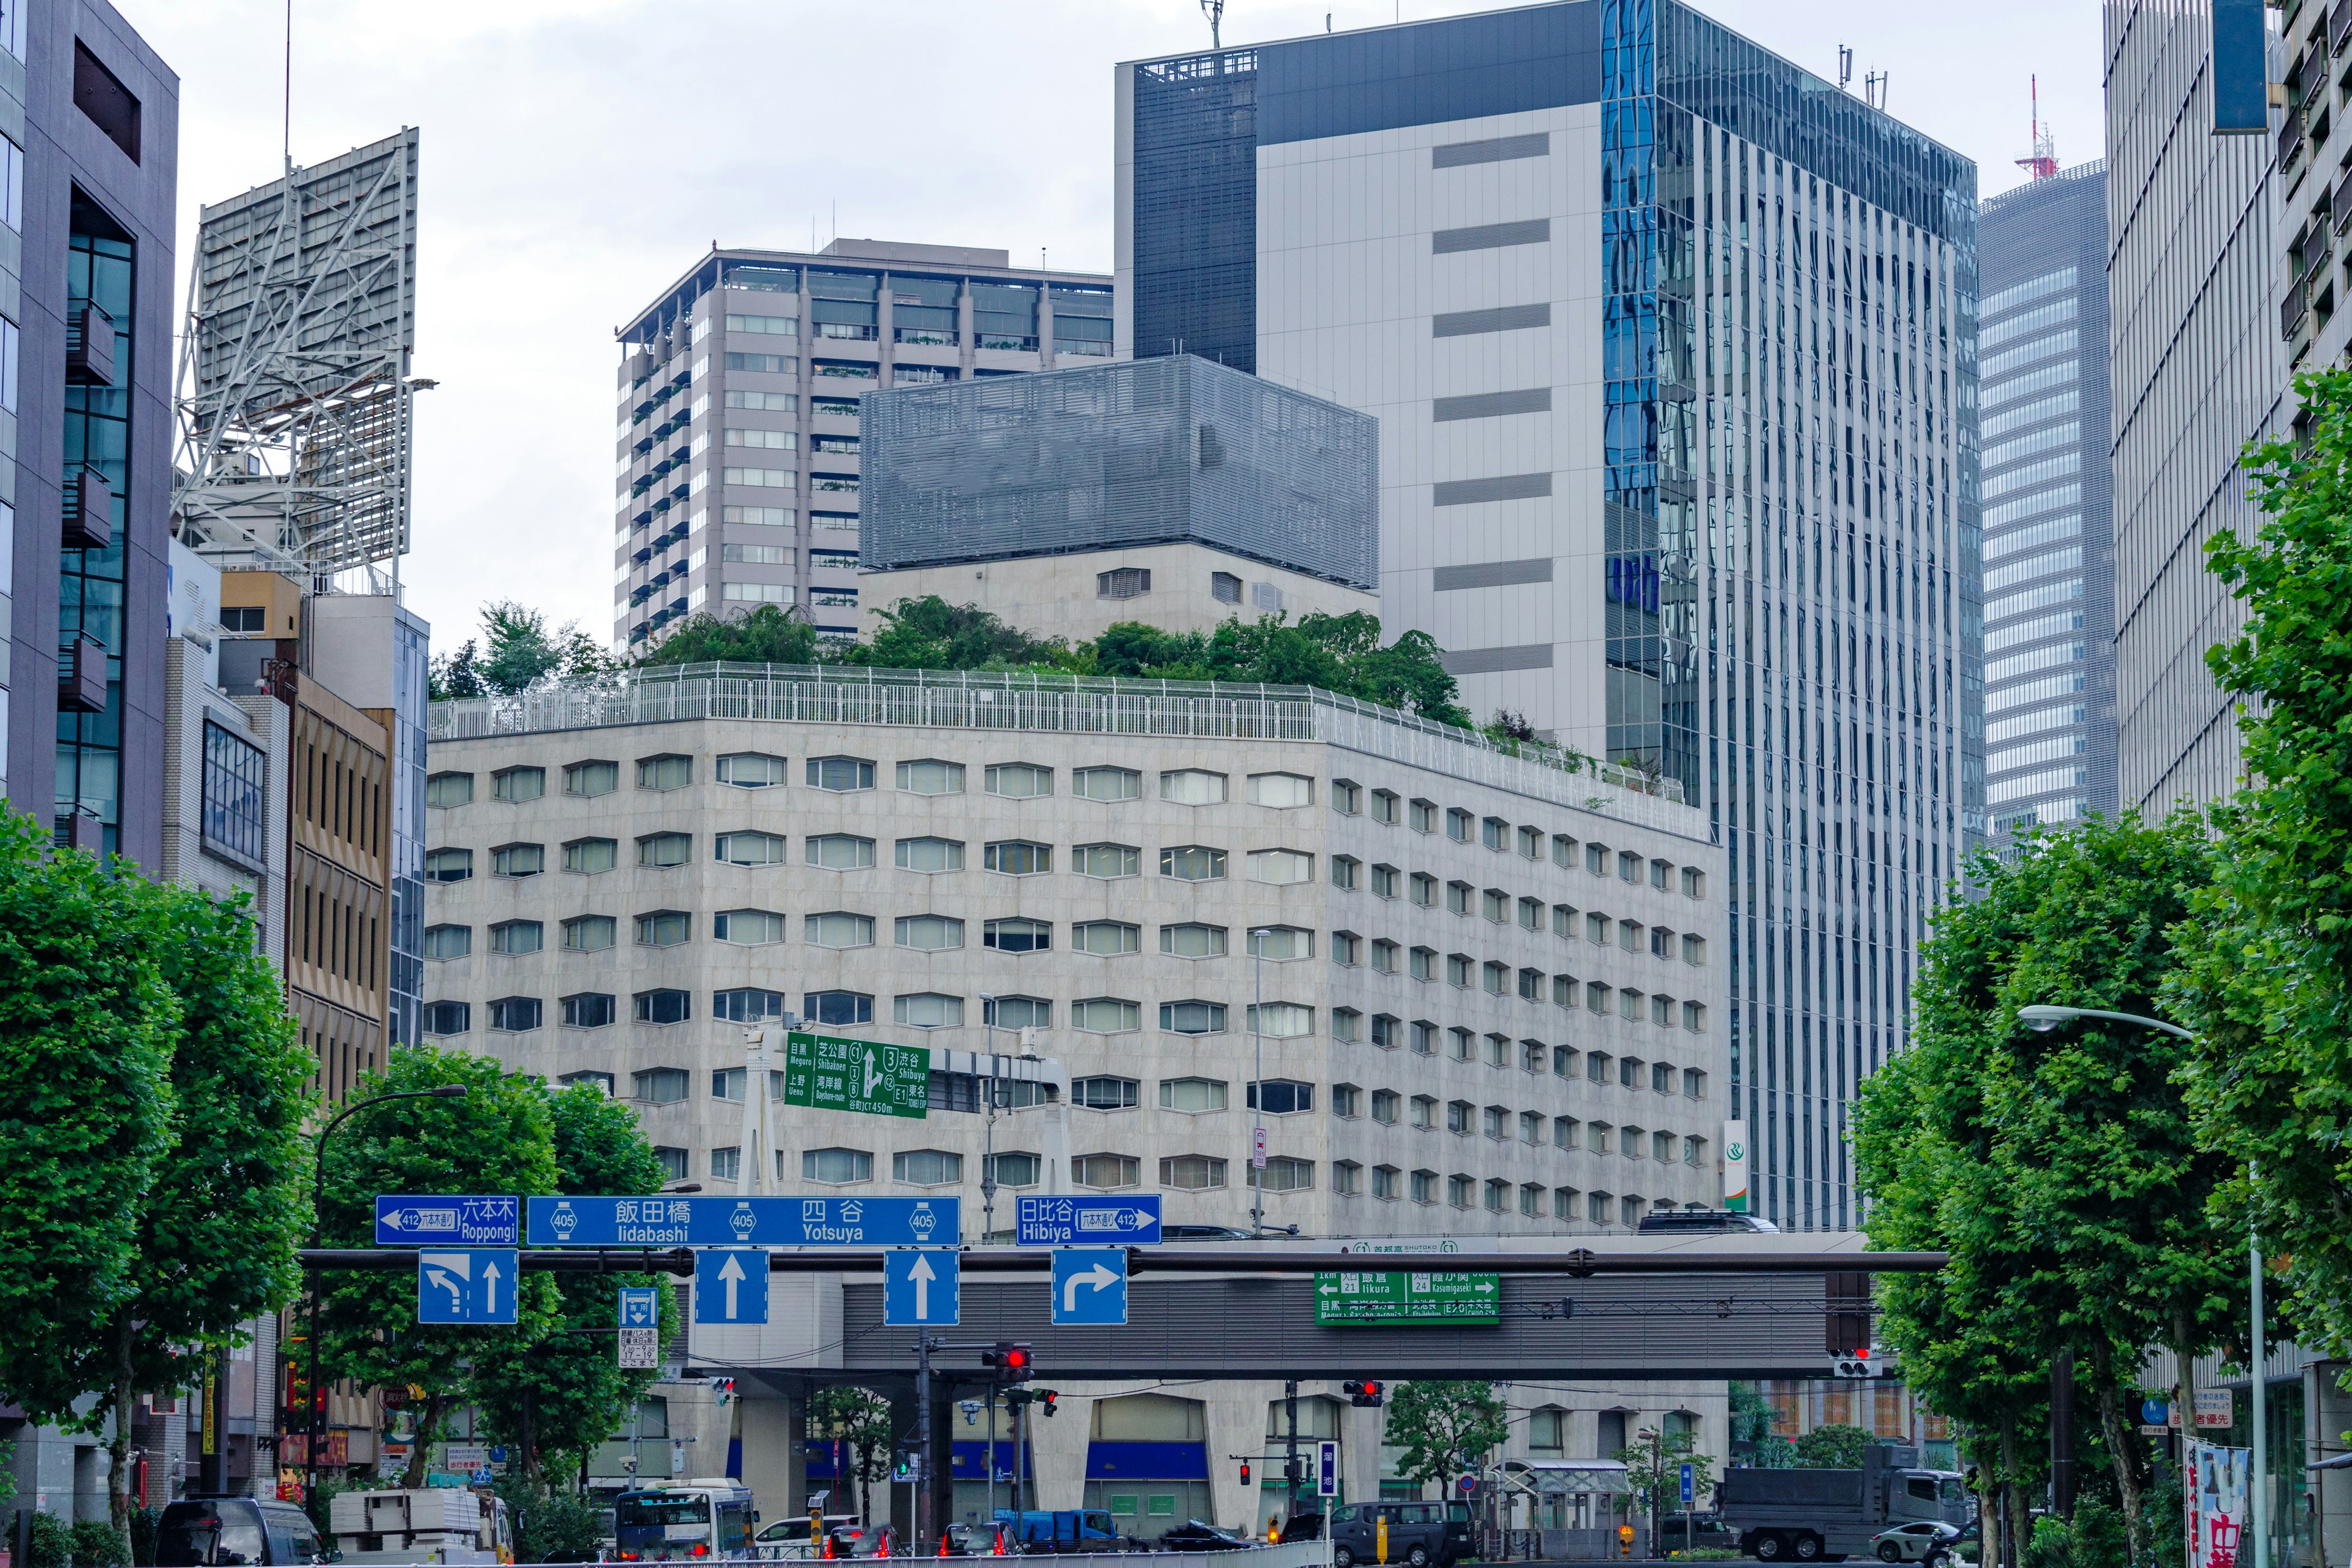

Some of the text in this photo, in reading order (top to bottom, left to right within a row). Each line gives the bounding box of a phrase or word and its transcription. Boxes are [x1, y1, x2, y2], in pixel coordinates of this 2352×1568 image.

[791, 1043, 806, 1055] 目黒
[819, 1042, 847, 1059] 芝公園
[851, 1047, 859, 1060] C1
[790, 1055, 812, 1066] Meguro
[818, 1058, 846, 1071] Shibakoen
[888, 1051, 894, 1066] 3
[900, 1052, 918, 1068] 渋谷
[853, 1069, 856, 1078] 1
[899, 1068, 925, 1082] Shibuya
[790, 1074, 805, 1087] 上野
[816, 1076, 842, 1090] 湾岸線
[886, 1078, 893, 1088] C2
[789, 1087, 803, 1096] Ueno
[816, 1090, 845, 1101] Bayshore-route
[851, 1085, 856, 1094] B
[896, 1088, 905, 1101] E1
[909, 1084, 924, 1098] 東名
[872, 1102, 892, 1114] 450m
[908, 1098, 919, 1107] TOMEI
[462, 1198, 514, 1221] 六本木
[615, 1200, 691, 1223] 飯田橋
[803, 1200, 863, 1223] 四谷
[1022, 1199, 1073, 1222] 日比谷
[402, 1213, 453, 1227] 412 六本木通り
[554, 1215, 573, 1227] 405
[733, 1215, 753, 1227] 405
[913, 1215, 932, 1227] 405
[1083, 1213, 1134, 1227] 六本木通り 412
[462, 1223, 514, 1243] Roppongi
[619, 1225, 688, 1242] Iidabashi
[803, 1224, 863, 1243] Yotsuya
[1023, 1224, 1071, 1243] Hibiya
[1363, 1284, 1390, 1293] Iikura
[1433, 1283, 1471, 1294] Kasumigaseki
[1322, 1300, 1340, 1311] 目黒
[1412, 1299, 1436, 1310] 北池袋
[1446, 1303, 1464, 1313] E20
[386, 1392, 408, 1403] 消火栓
[2173, 1414, 2228, 1424] 歩者優先
[1324, 1452, 1333, 1485] 溜池
